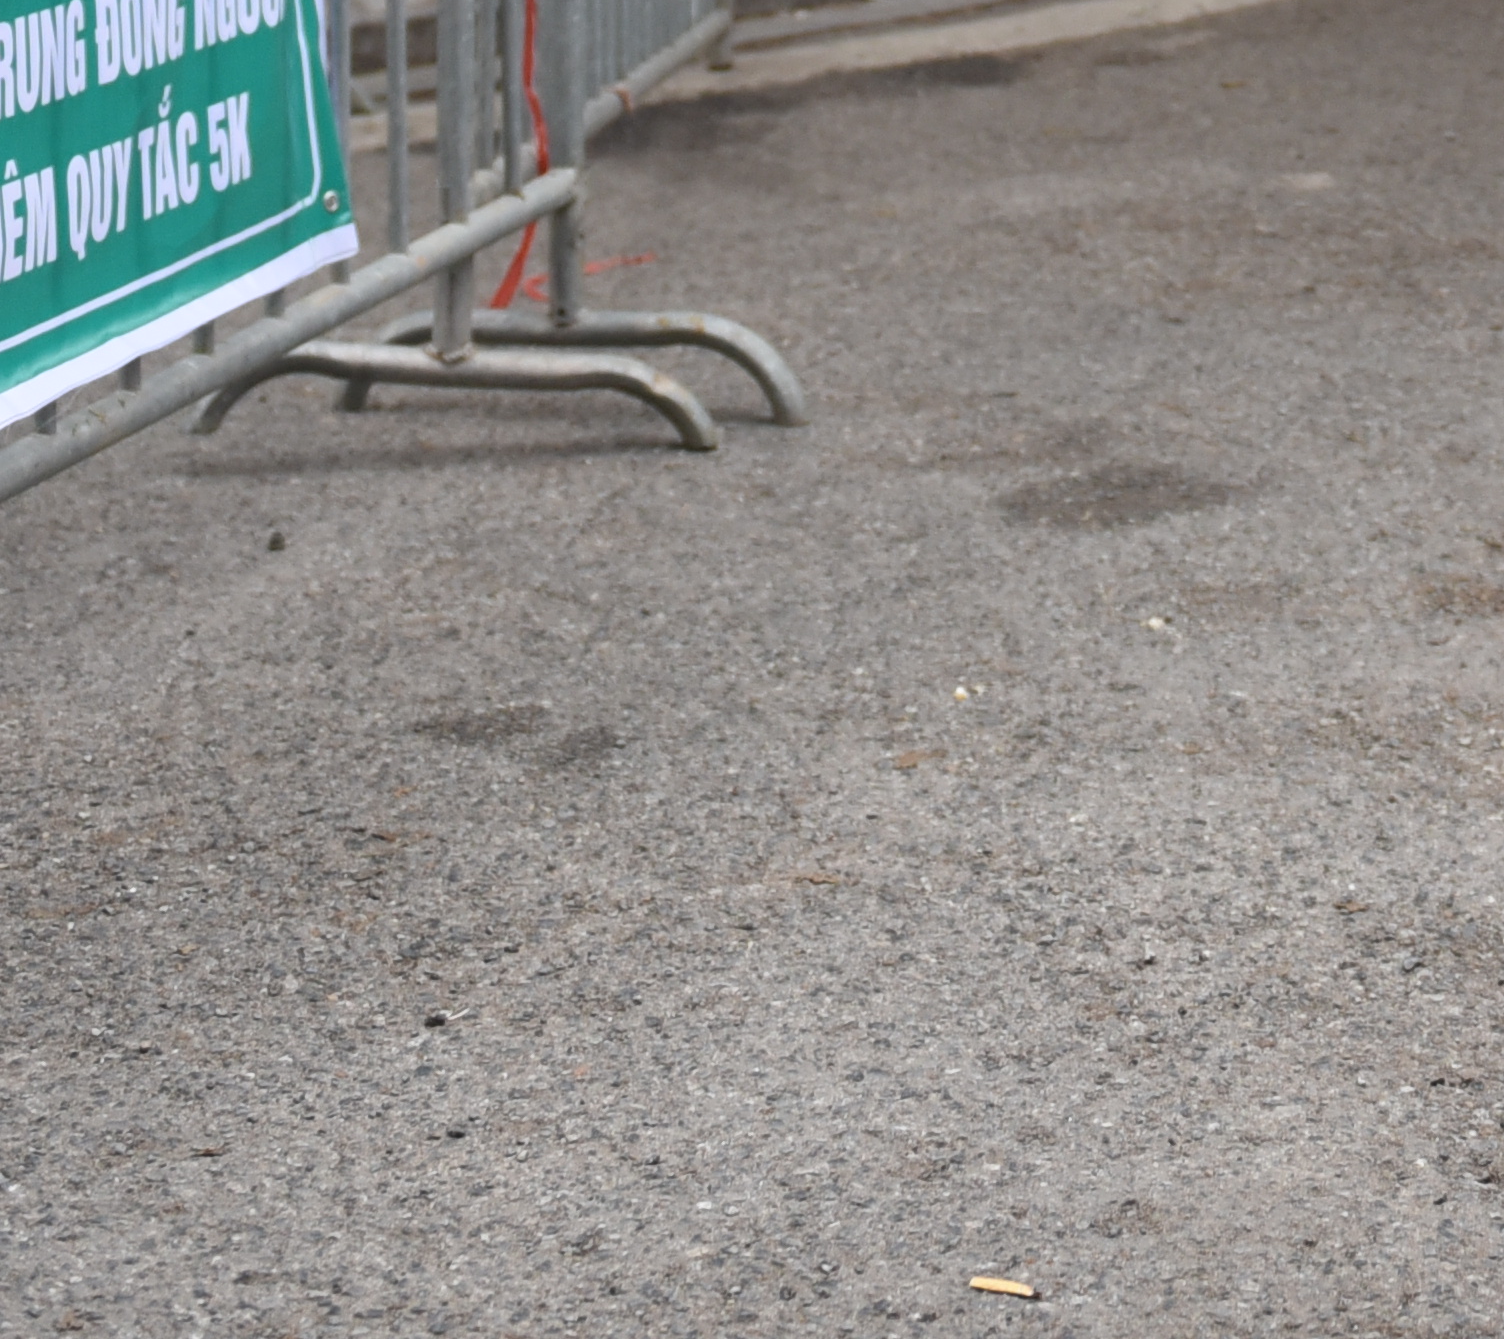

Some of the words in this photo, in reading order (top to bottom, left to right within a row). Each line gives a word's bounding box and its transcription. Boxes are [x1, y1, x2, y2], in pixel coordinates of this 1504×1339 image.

[67, 138, 132, 259] QUY
[138, 86, 199, 219] TẮC
[208, 93, 250, 191] 5K
